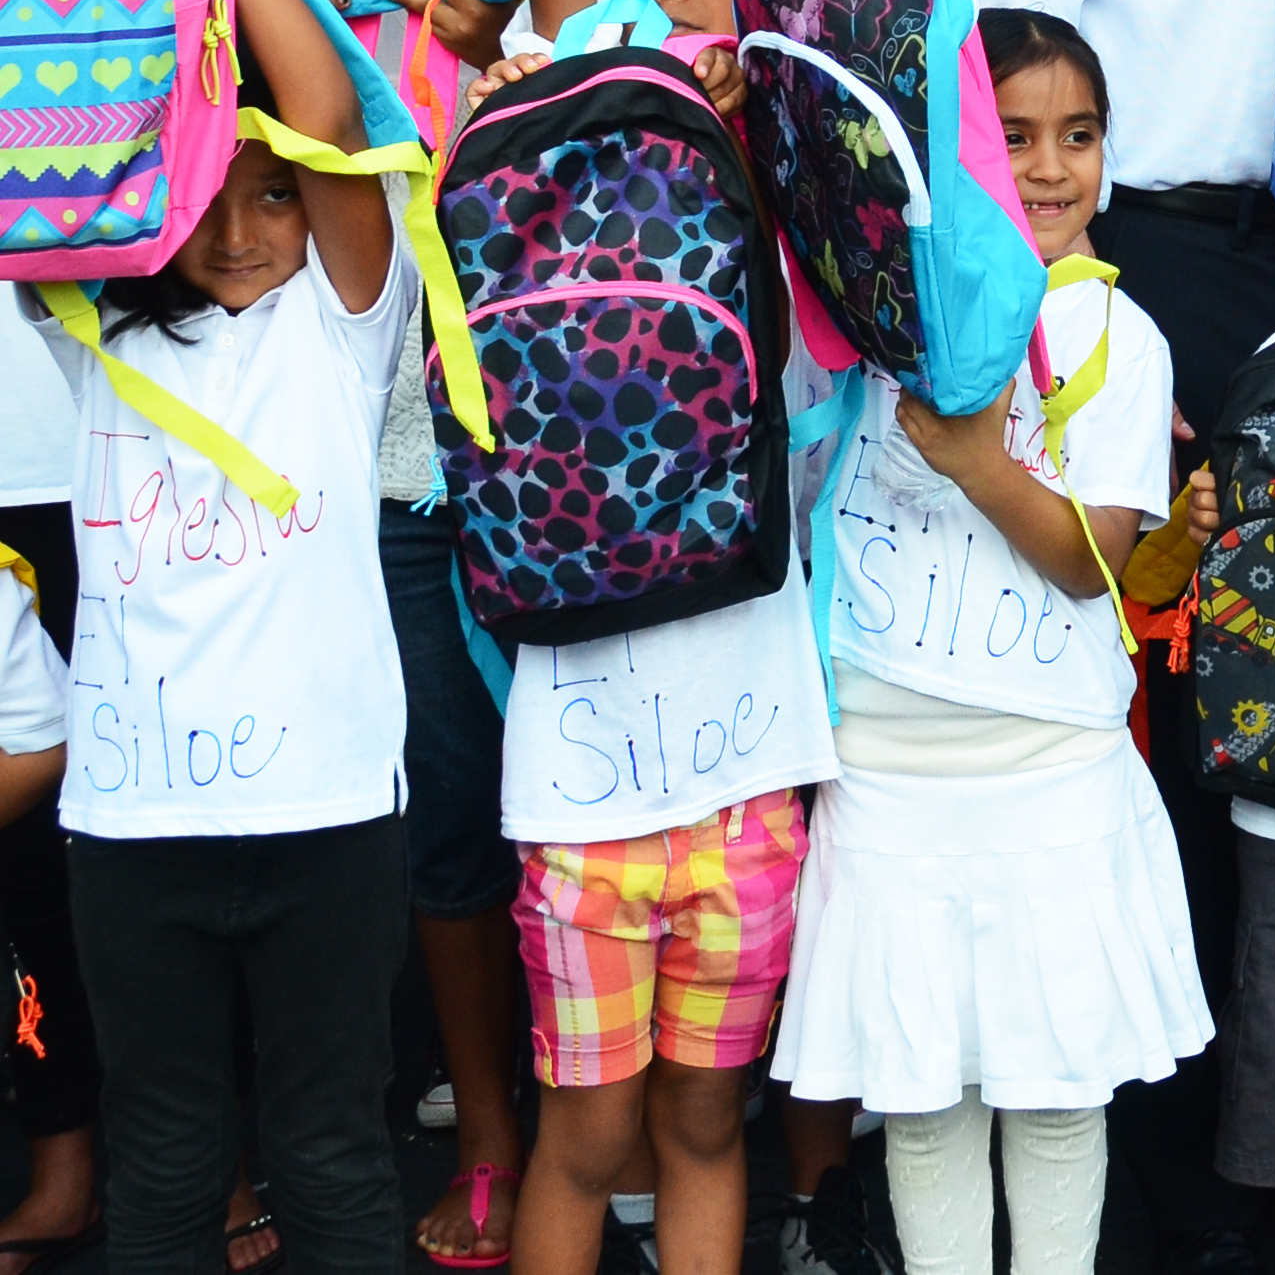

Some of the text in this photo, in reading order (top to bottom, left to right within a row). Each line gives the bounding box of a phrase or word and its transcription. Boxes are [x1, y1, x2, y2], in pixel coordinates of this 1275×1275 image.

[74, 591, 130, 690] El
[845, 533, 1073, 664] Siloe
[84, 676, 288, 792] Siloe
[551, 692, 780, 805] Siloe
